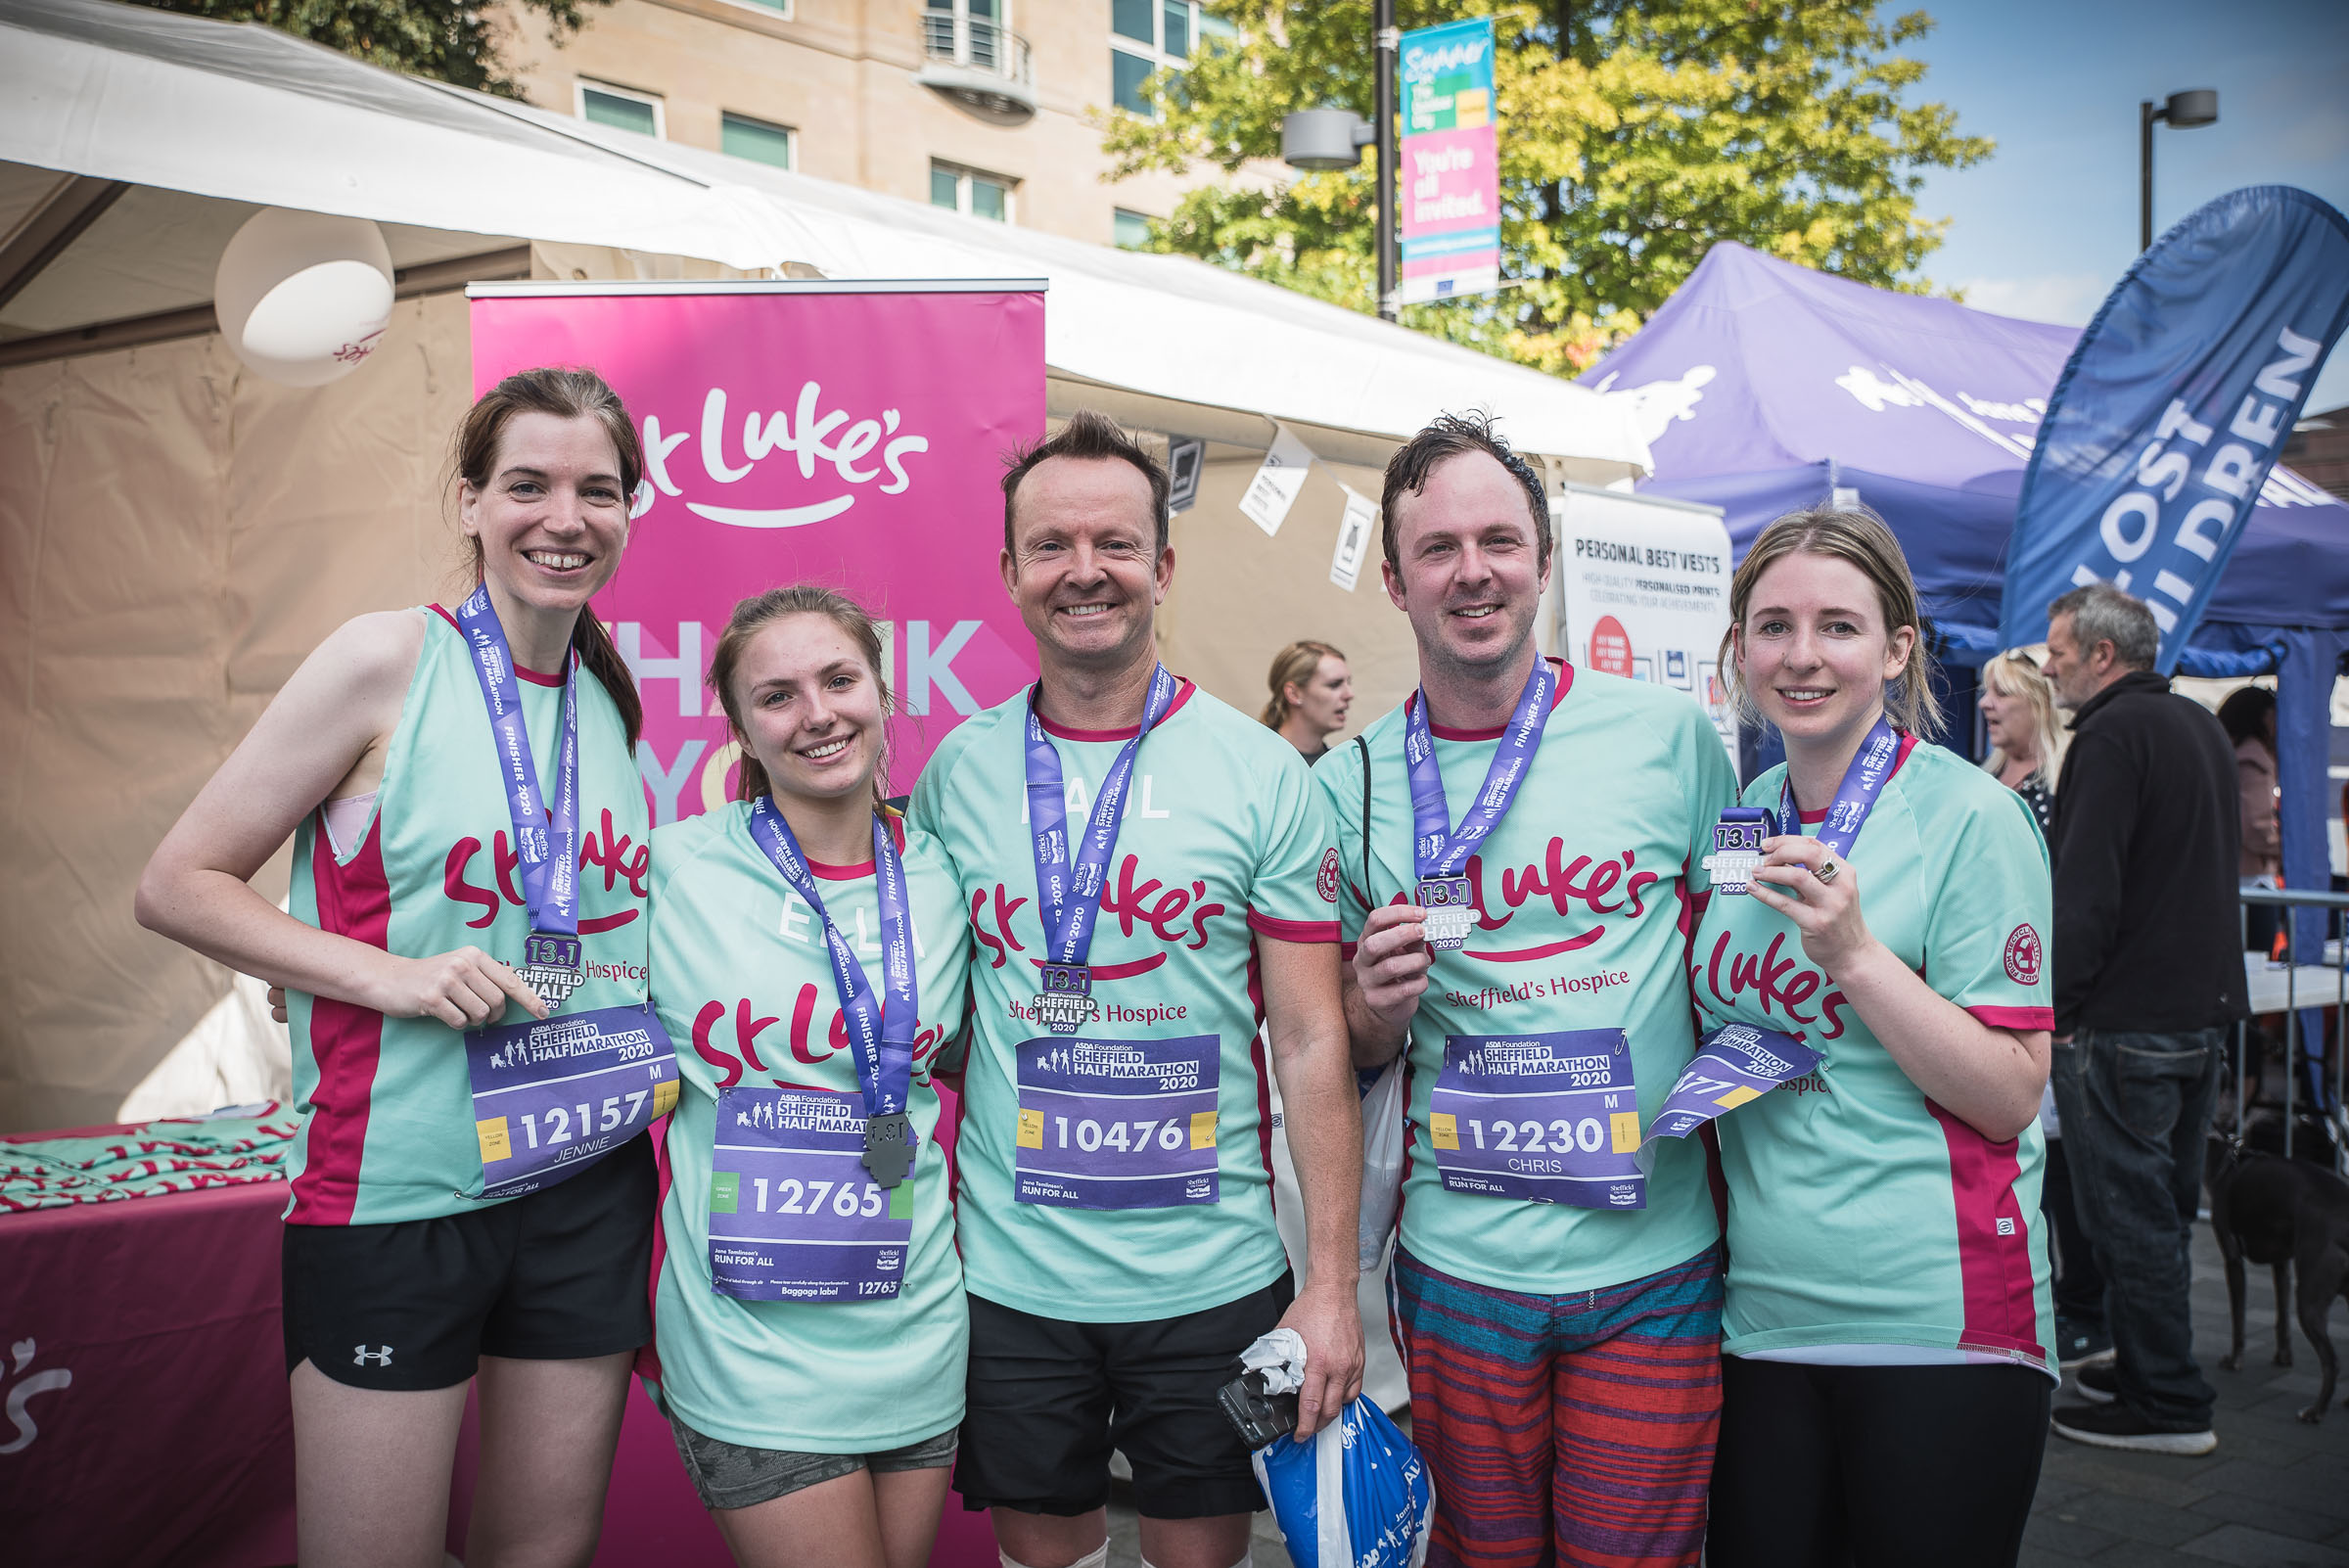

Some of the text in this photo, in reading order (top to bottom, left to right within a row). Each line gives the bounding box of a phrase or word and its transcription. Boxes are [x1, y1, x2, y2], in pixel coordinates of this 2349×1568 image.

[701, 381, 929, 495] Luke's
[1575, 538, 1721, 575] PERSONAL BEST VESTS
[1636, 579, 1690, 594] PERSONALISED
[487, 646, 503, 684] SHEFFIELD
[478, 647, 504, 715] HALF MARATHON
[1514, 703, 1540, 749] FINISHER
[1533, 676, 1546, 704] 2020
[1866, 735, 1890, 769] SHEFFIELD
[1873, 753, 1889, 771] HALF
[504, 725, 533, 816] FINISHER 2020
[563, 736, 575, 817] FINISHER 2020
[1495, 757, 1524, 808] HALF MARATHON
[1105, 759, 1130, 828] HALF MARATHON
[1487, 776, 1505, 807] SHEFFIELD
[1098, 787, 1114, 827] SHEFFIELD
[1828, 800, 1846, 829] Sheffield
[767, 818, 806, 877] HALF MARATHON
[1036, 834, 1048, 864] Sheffield
[1717, 828, 1763, 849] 13.1
[555, 853, 566, 894] SHEFFIELD
[563, 828, 574, 897] HALF MARATHON
[775, 846, 800, 882] SHEFFIELD
[887, 850, 898, 901] FINISHER
[1050, 874, 1062, 906] 2020
[1073, 862, 1086, 894] Sheffield
[1465, 836, 1658, 931] Luke's
[1721, 883, 1747, 893] 2020
[1421, 883, 1469, 906] 13.1
[895, 911, 907, 958] MARATHON
[971, 883, 1029, 969] St
[1069, 906, 1085, 941] 2020
[530, 940, 578, 966] 13.1
[1436, 939, 1461, 948] 2020
[516, 969, 584, 987] SHEFFIELD
[584, 959, 648, 983] Hospice
[836, 947, 855, 999] MARATHON
[1045, 970, 1087, 992] 13.1
[1034, 996, 1095, 1011] SHEFFIELD
[1446, 969, 1631, 1011] Sheffield's Hospice
[530, 1019, 586, 1035] ASDA Foundation
[1041, 1008, 1085, 1024] HALF
[1051, 1023, 1076, 1033] 2020
[1107, 1002, 1187, 1026] Hospice
[530, 1025, 598, 1049] SHEFFIELD
[531, 1031, 648, 1062] HALF MARATHON
[691, 996, 781, 1088] St
[856, 1006, 878, 1064] FINISHER
[1075, 1041, 1094, 1050] ASDA
[618, 1042, 654, 1062] 2020
[1074, 1049, 1143, 1064] SHEFFIELD
[1486, 1047, 1550, 1062] SHEFFIELD
[1487, 1056, 1609, 1075] HALF MARATHON
[1727, 1038, 1792, 1073] MARATHON
[649, 1064, 663, 1080] M
[1074, 1061, 1198, 1078] HALF MARATHON
[1159, 1075, 1198, 1090] 2020
[1570, 1071, 1612, 1087] 2020
[1744, 1060, 1780, 1077] 2020
[779, 1093, 841, 1104] ASDA Foundation
[779, 1104, 849, 1118] SHEFFIELD
[1604, 1093, 1619, 1108] M
[521, 1088, 649, 1149] 12157
[778, 1117, 867, 1133] HALF MARAT
[1055, 1116, 1184, 1153] 10476
[1468, 1117, 1604, 1154] 12230
[554, 1135, 611, 1163] JENNIE
[1507, 1158, 1563, 1174] CHRIS
[753, 1177, 883, 1218] 12765
[1022, 1185, 1079, 1199] RUN FOR ALL
[714, 1254, 774, 1267] RUN FOR ALL
[781, 1286, 839, 1298] Baggage label
[857, 1281, 897, 1294] 12765
